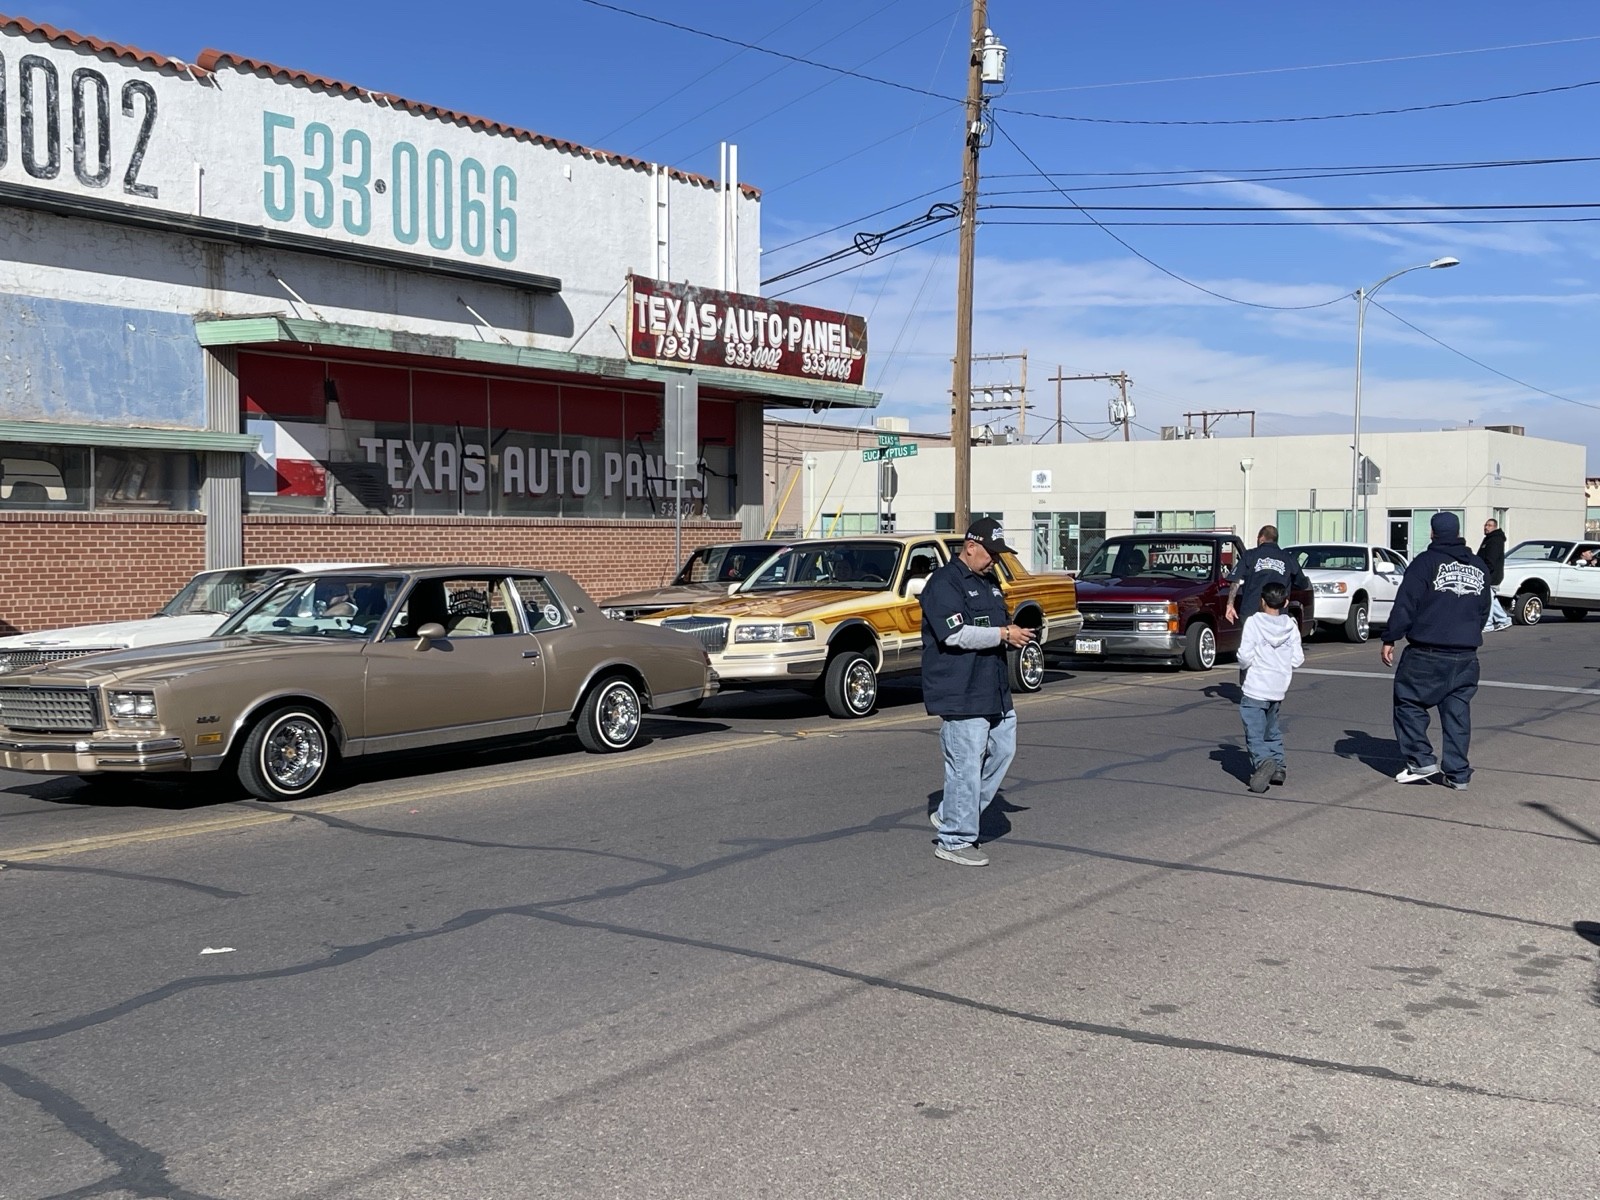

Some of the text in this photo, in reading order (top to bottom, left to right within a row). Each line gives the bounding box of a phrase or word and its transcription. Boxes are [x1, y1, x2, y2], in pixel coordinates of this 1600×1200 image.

[0, 50, 158, 199] 002
[634, 292, 717, 340] TEXAS
[724, 306, 783, 349] AUTO
[656, 335, 699, 361] 1931
[359, 437, 708, 499] TEXAS AUTO PANLS
[878, 435, 894, 446] TEXAS
